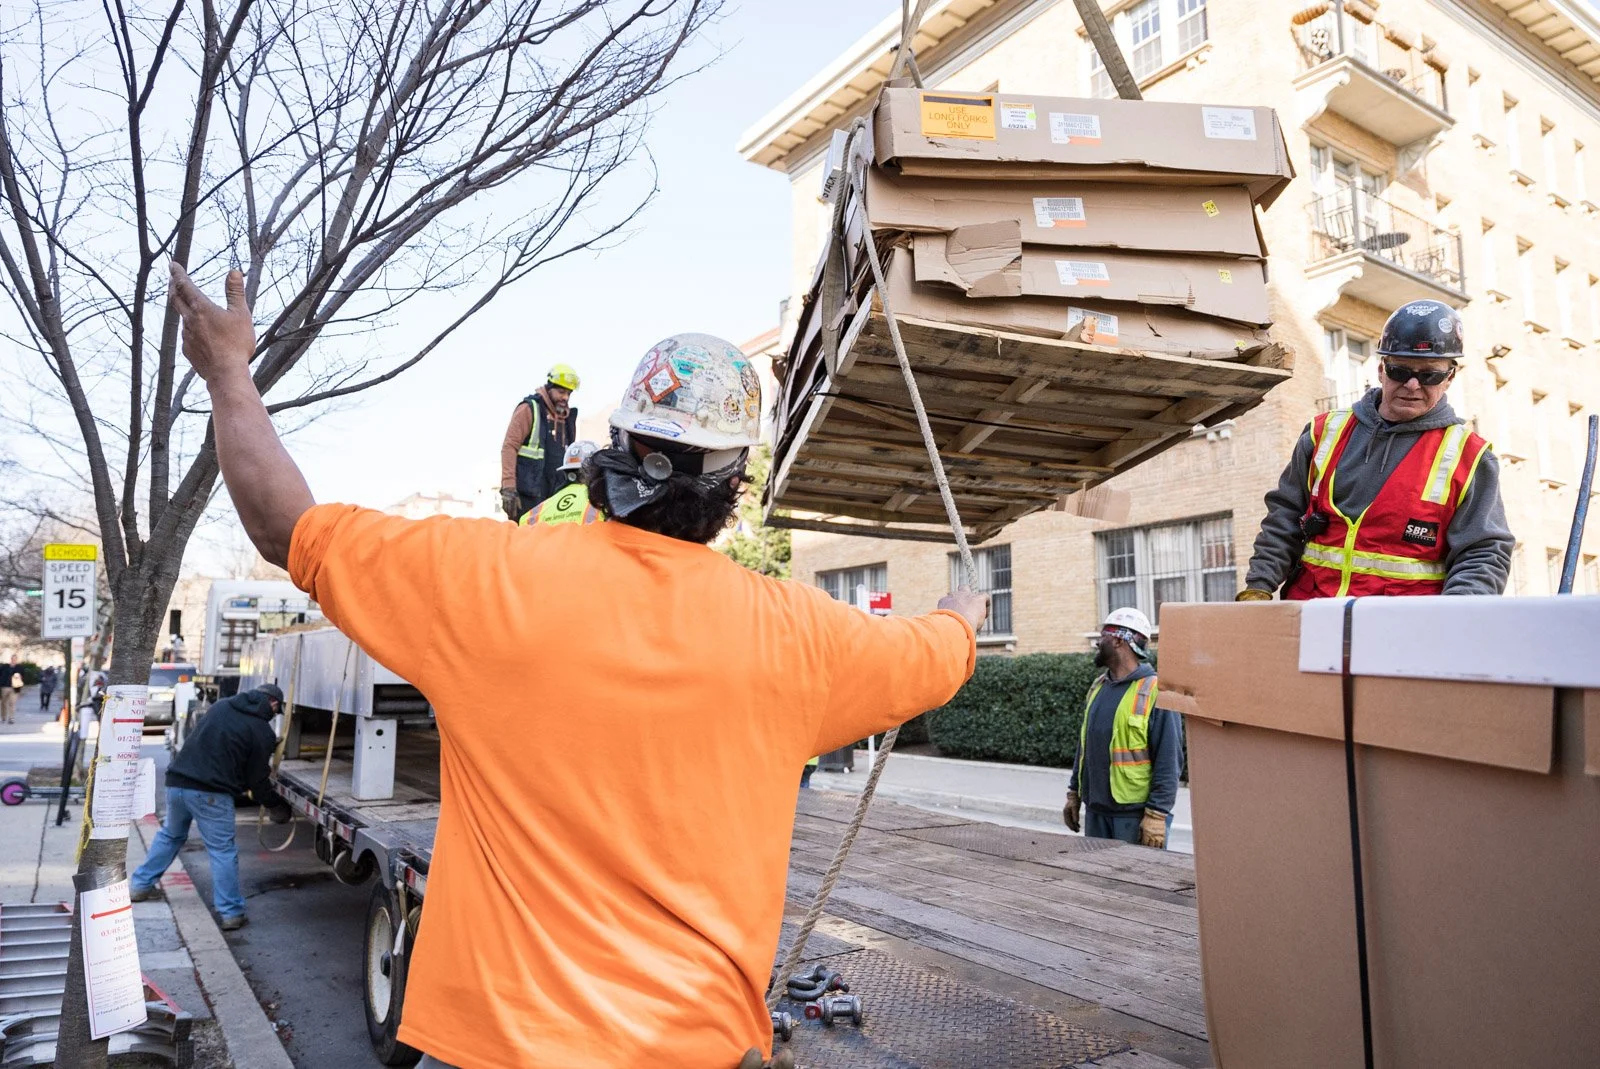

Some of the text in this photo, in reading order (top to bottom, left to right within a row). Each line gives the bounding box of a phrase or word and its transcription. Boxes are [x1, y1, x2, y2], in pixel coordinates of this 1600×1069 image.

[948, 106, 967, 114] USE
[929, 112, 988, 123] LONG FORKS
[947, 121, 971, 129] ONLY
[1406, 524, 1428, 536] SBP
[51, 548, 90, 557] SCHOOL
[50, 563, 90, 572] SPEED
[54, 575, 86, 583] LIMIT
[53, 589, 86, 609] 15
